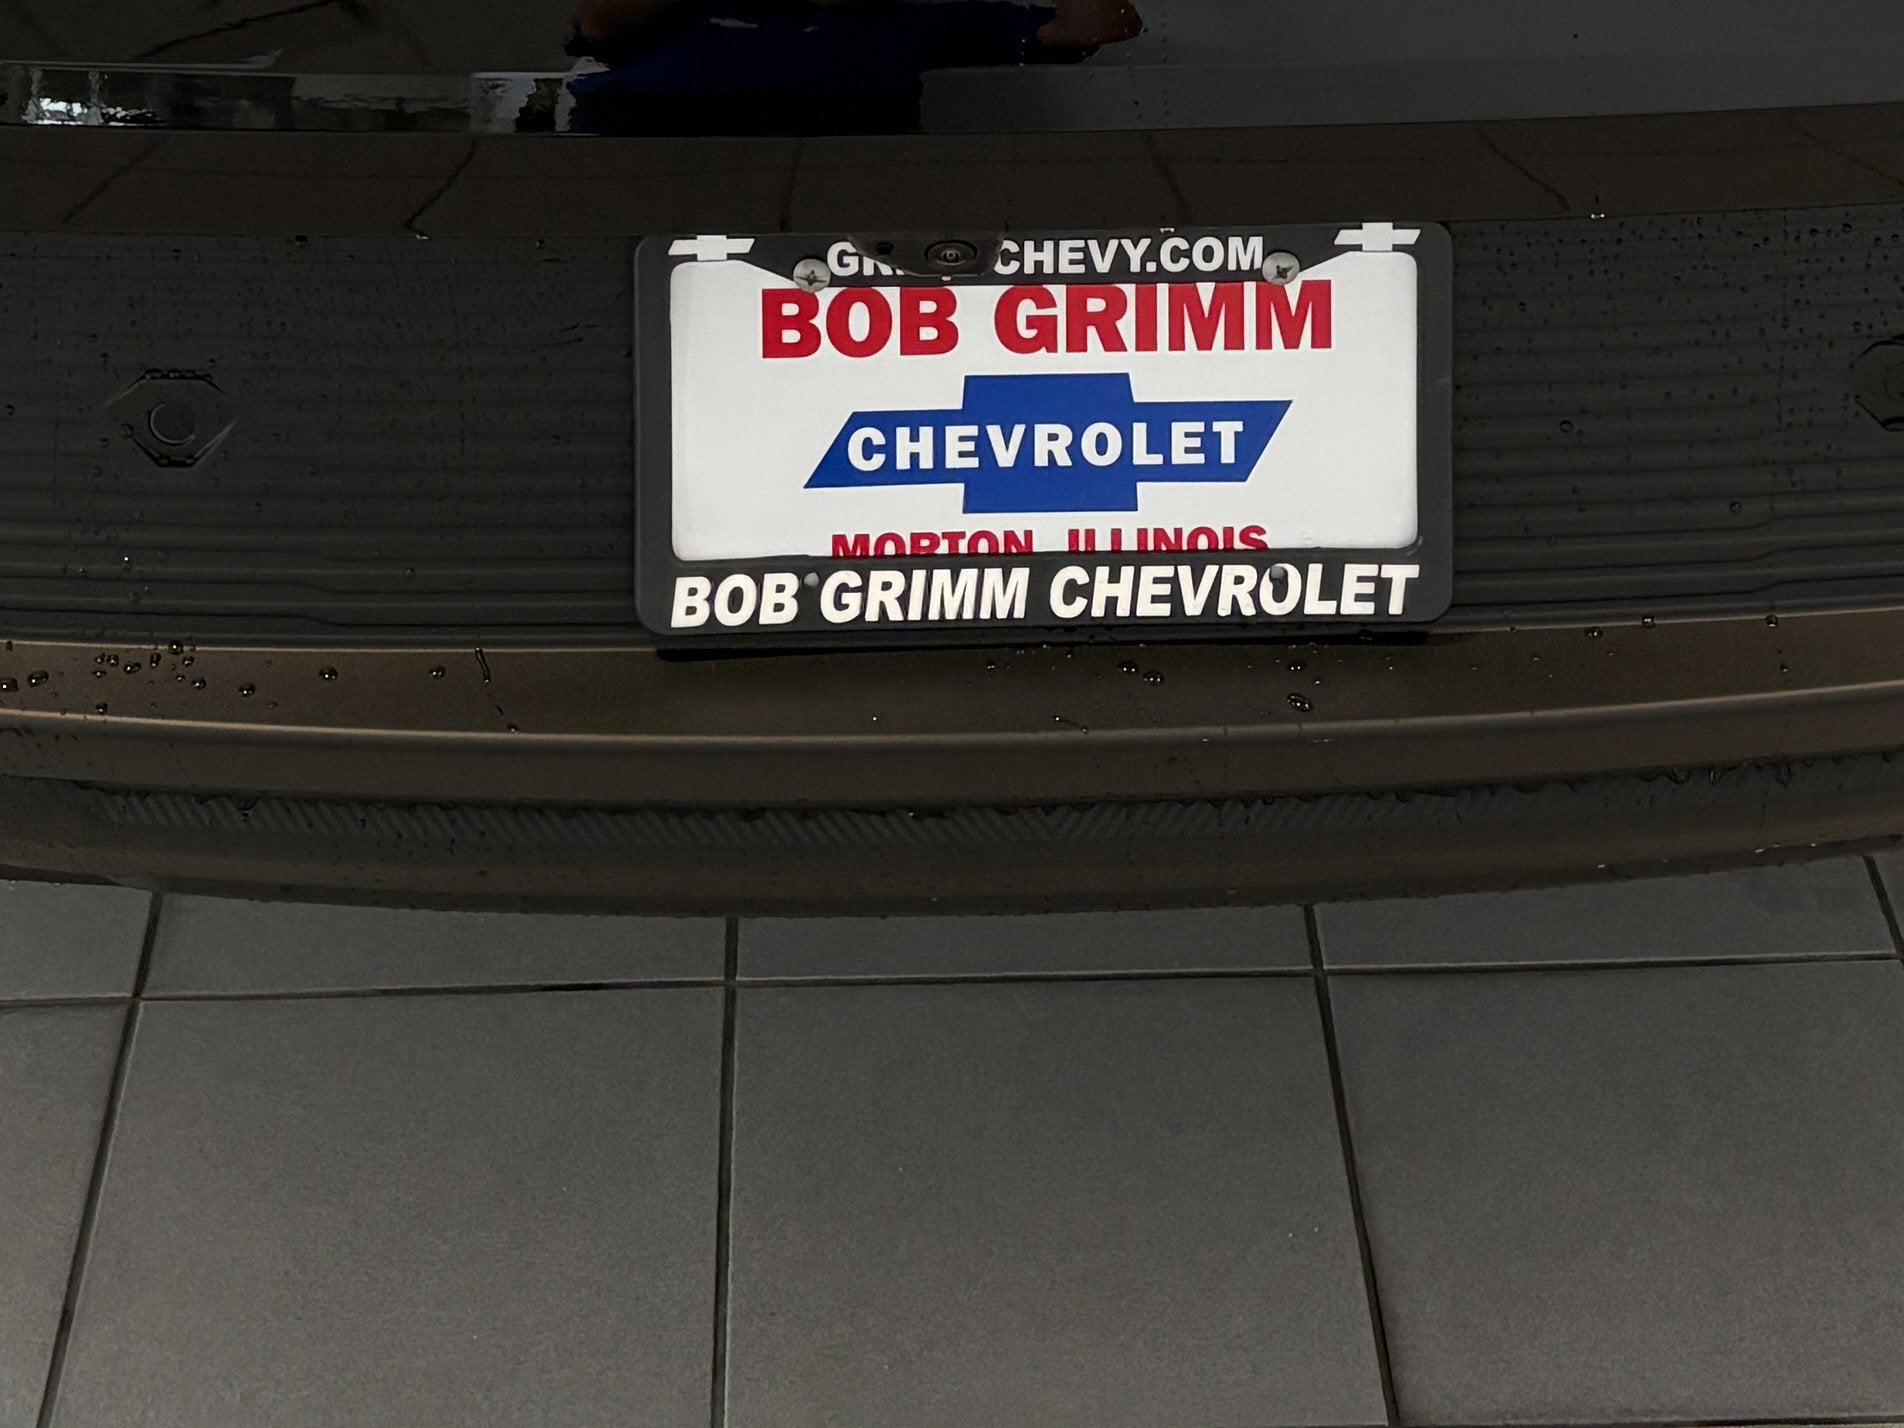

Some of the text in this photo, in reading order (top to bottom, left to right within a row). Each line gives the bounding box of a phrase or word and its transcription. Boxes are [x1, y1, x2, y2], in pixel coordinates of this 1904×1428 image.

[827, 235, 1264, 278] GCHEVY.COM
[761, 280, 1332, 359] BOB GRIMM
[847, 420, 1243, 472] CHEVROLET
[671, 562, 1420, 628] BOB GRIMM CHEVROLET
